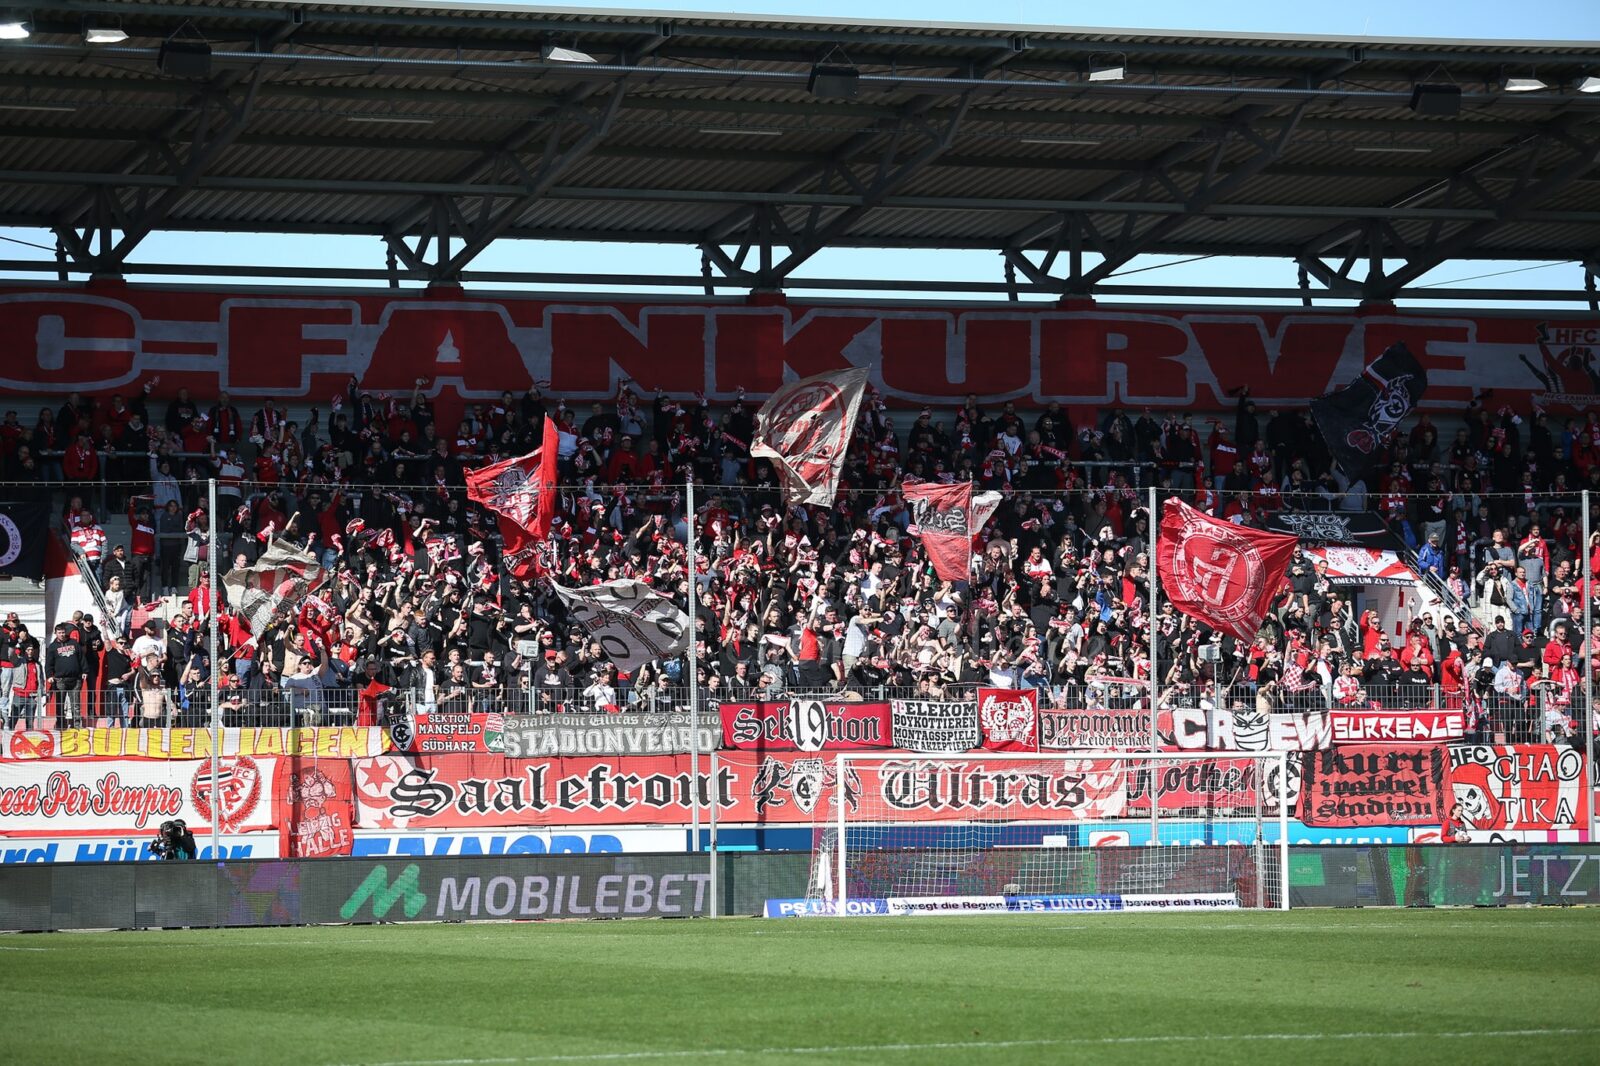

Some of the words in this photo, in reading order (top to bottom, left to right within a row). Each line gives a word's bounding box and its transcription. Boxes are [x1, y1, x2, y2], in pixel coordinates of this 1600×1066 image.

[1555, 329, 1597, 343] HFC
[428, 714, 471, 723] SEKTION
[893, 714, 976, 729] BOYKOTTIEREN
[418, 724, 481, 735] MANSFELD
[893, 727, 976, 741] MONTAGSSPIELE
[1332, 716, 1464, 739] SURREALE
[60, 727, 224, 758] BULLEN
[235, 727, 370, 758] JAGEN
[421, 737, 476, 751] SÜDHARZ
[894, 738, 920, 749] NICHT
[1450, 747, 1489, 767] HFC
[1493, 748, 1583, 785] CHAO
[389, 763, 738, 818] Saalefront
[880, 758, 1087, 811] Ultras
[0, 783, 42, 816] esa
[41, 770, 92, 818] Per
[91, 771, 183, 829] Sempre
[1497, 797, 1576, 825] TIKA
[75, 839, 253, 862] Hüber
[435, 874, 712, 917] MOBILEBET
[1126, 898, 1170, 909] bewegt
[1173, 898, 1190, 907] die
[1193, 897, 1234, 908] Region
[779, 902, 807, 915] PS
[811, 902, 878, 914] UNON
[892, 901, 937, 912] bewegt
[940, 901, 960, 910] die
[962, 901, 1003, 912] Region
[1019, 900, 1044, 911] PS
[1050, 899, 1112, 910] UNION
